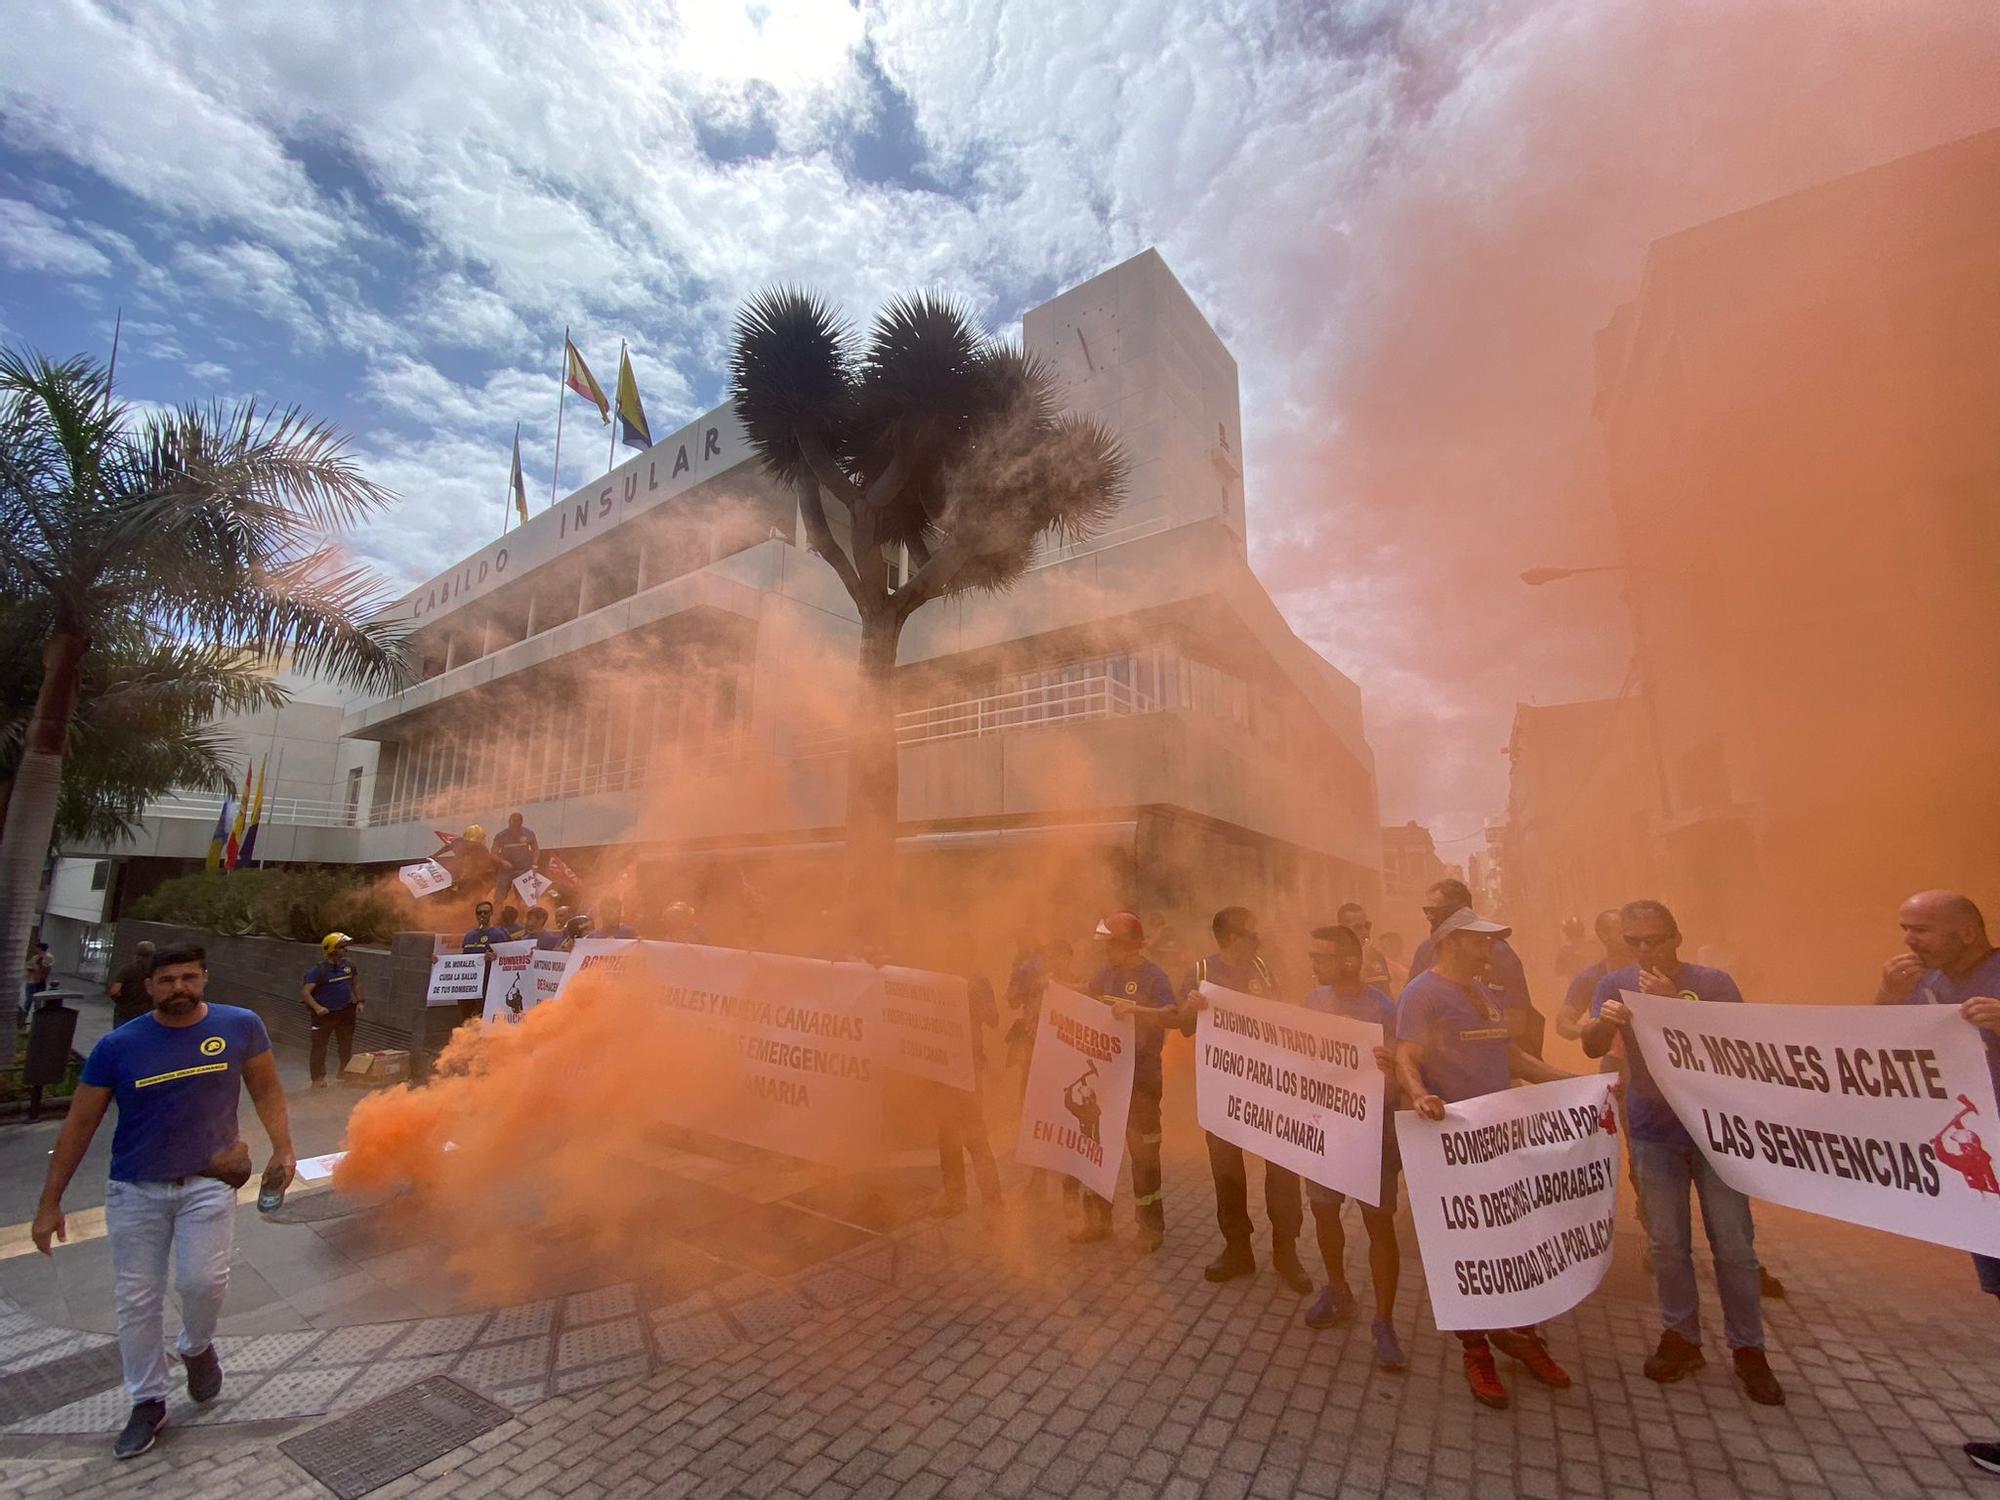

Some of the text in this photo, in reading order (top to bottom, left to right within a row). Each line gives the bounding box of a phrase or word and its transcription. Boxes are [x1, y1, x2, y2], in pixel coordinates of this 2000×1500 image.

[413, 427, 721, 618] CABILDO INSULAR
[454, 973, 460, 981] LA
[461, 972, 477, 981] SALUD
[720, 995, 771, 1025] NUEVA
[775, 1005, 864, 1042] CANARIAS
[1050, 1009, 1122, 1054] BOMBEROS
[1213, 1007, 1359, 1070] EXIGIMOS UN TRATO JUSTO
[747, 1036, 872, 1082] EMERGENCIAS
[1204, 1044, 1367, 1122] Y DIGNO PARA LOS BOMBEROS
[1662, 1026, 1948, 1100] SR. MORALES ACATE
[1033, 1120, 1104, 1168] EN LUCHA
[1227, 1095, 1326, 1157] DE GRAN CANARIA
[1441, 1104, 1599, 1166] BOMBEROS EN LUCHA POR
[1702, 1108, 1940, 1198] LAS SENTENCIAS
[1441, 1195, 1479, 1230] LOS
[1526, 1161, 1604, 1209] LABORABLES
[1603, 1157, 1612, 1188] Y
[1455, 1252, 1544, 1296] SEGURIDAD
[1536, 1243, 1556, 1277] DE
[1549, 1235, 1567, 1275] LA
